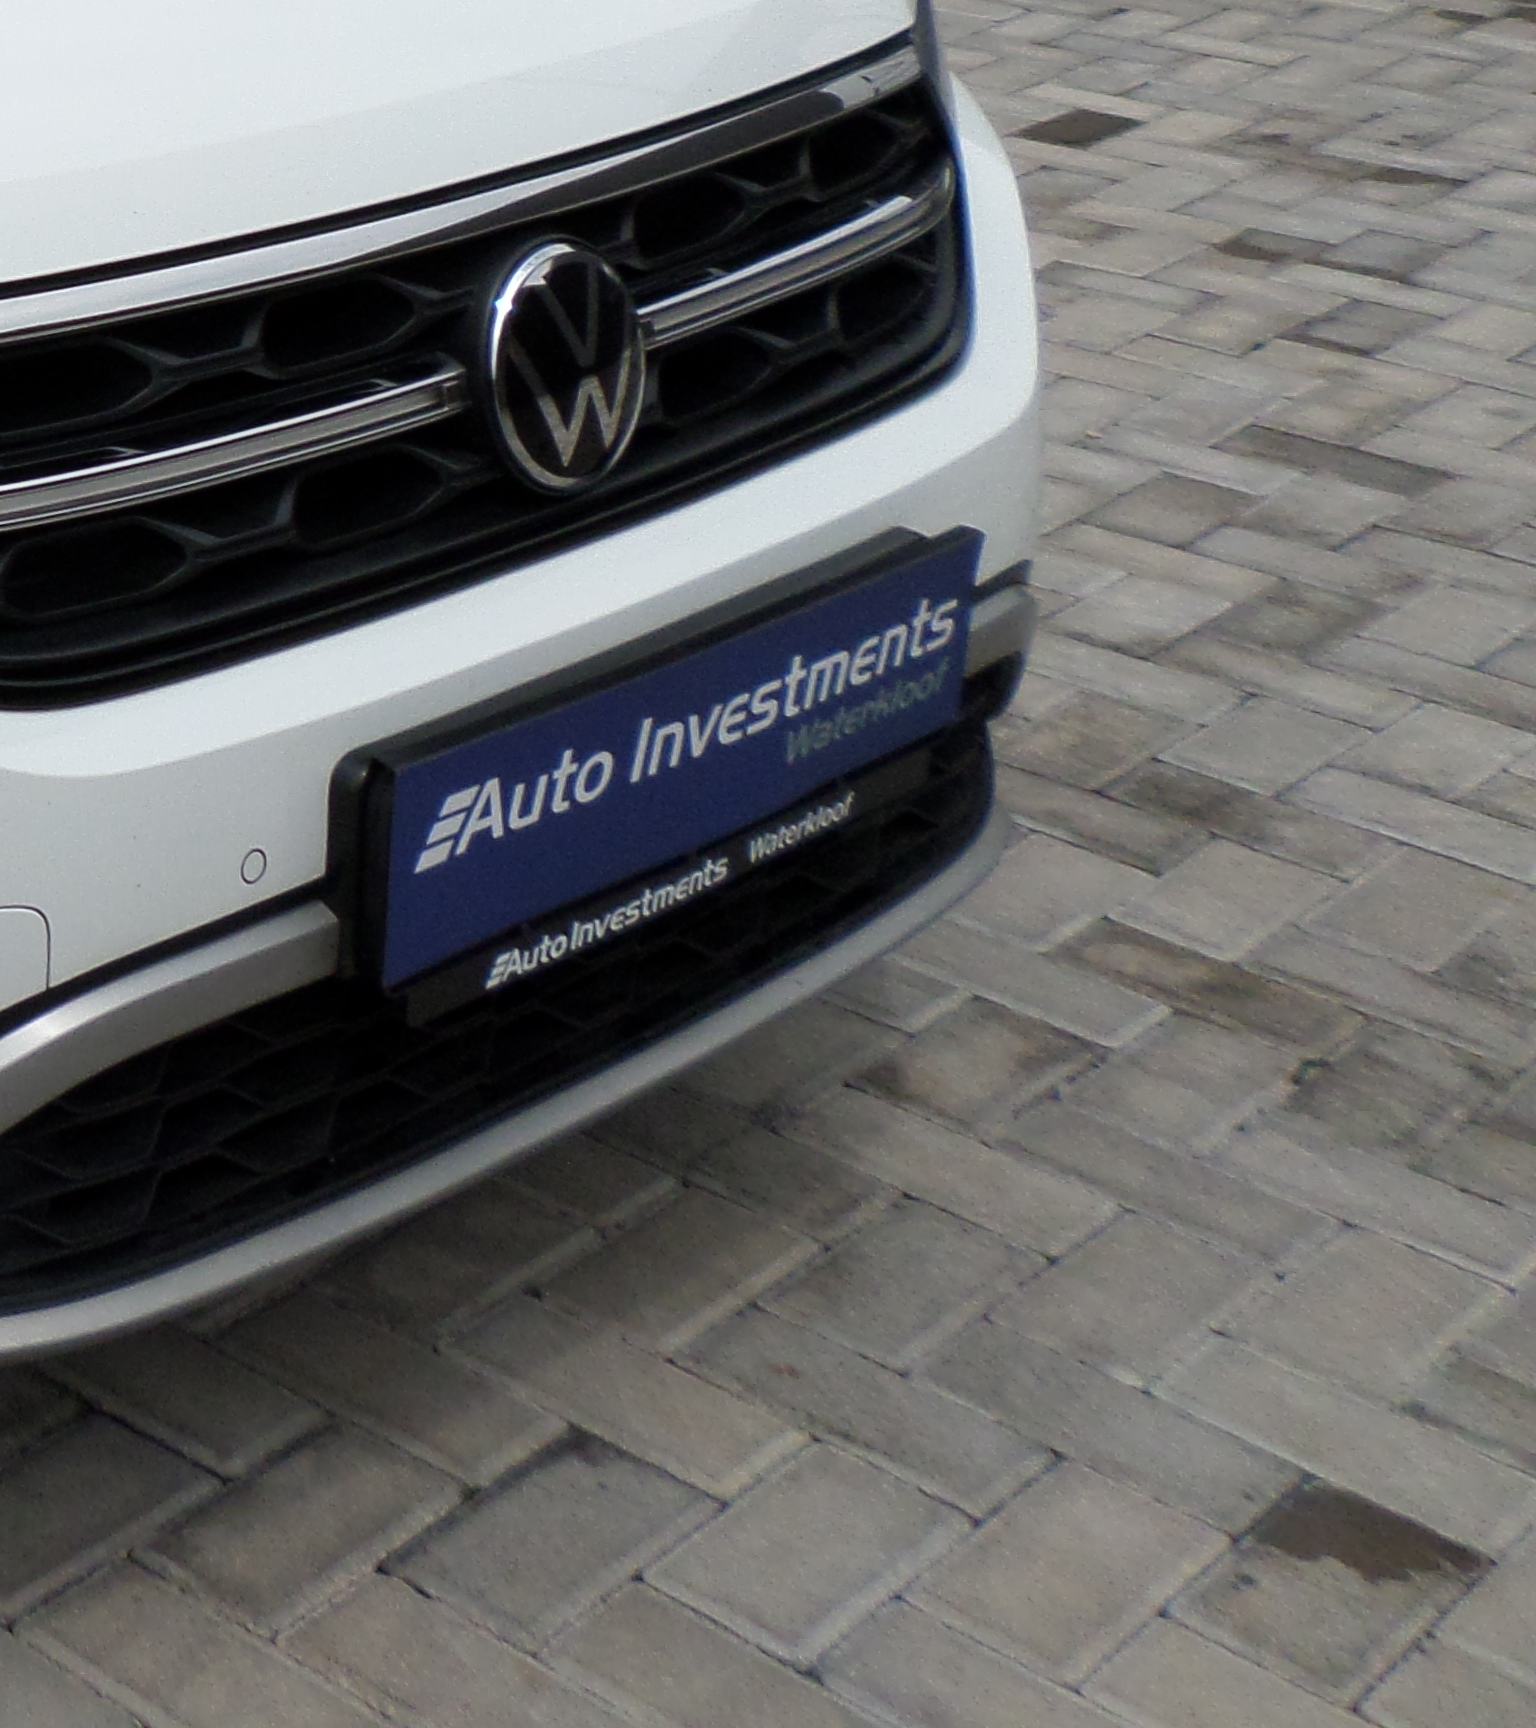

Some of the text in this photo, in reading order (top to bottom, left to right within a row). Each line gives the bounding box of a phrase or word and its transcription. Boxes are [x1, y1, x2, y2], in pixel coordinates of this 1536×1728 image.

[456, 598, 959, 854] Auto Investments
[786, 656, 950, 765] Waterkloof
[503, 789, 856, 984] Auto Investments Waterkloof
